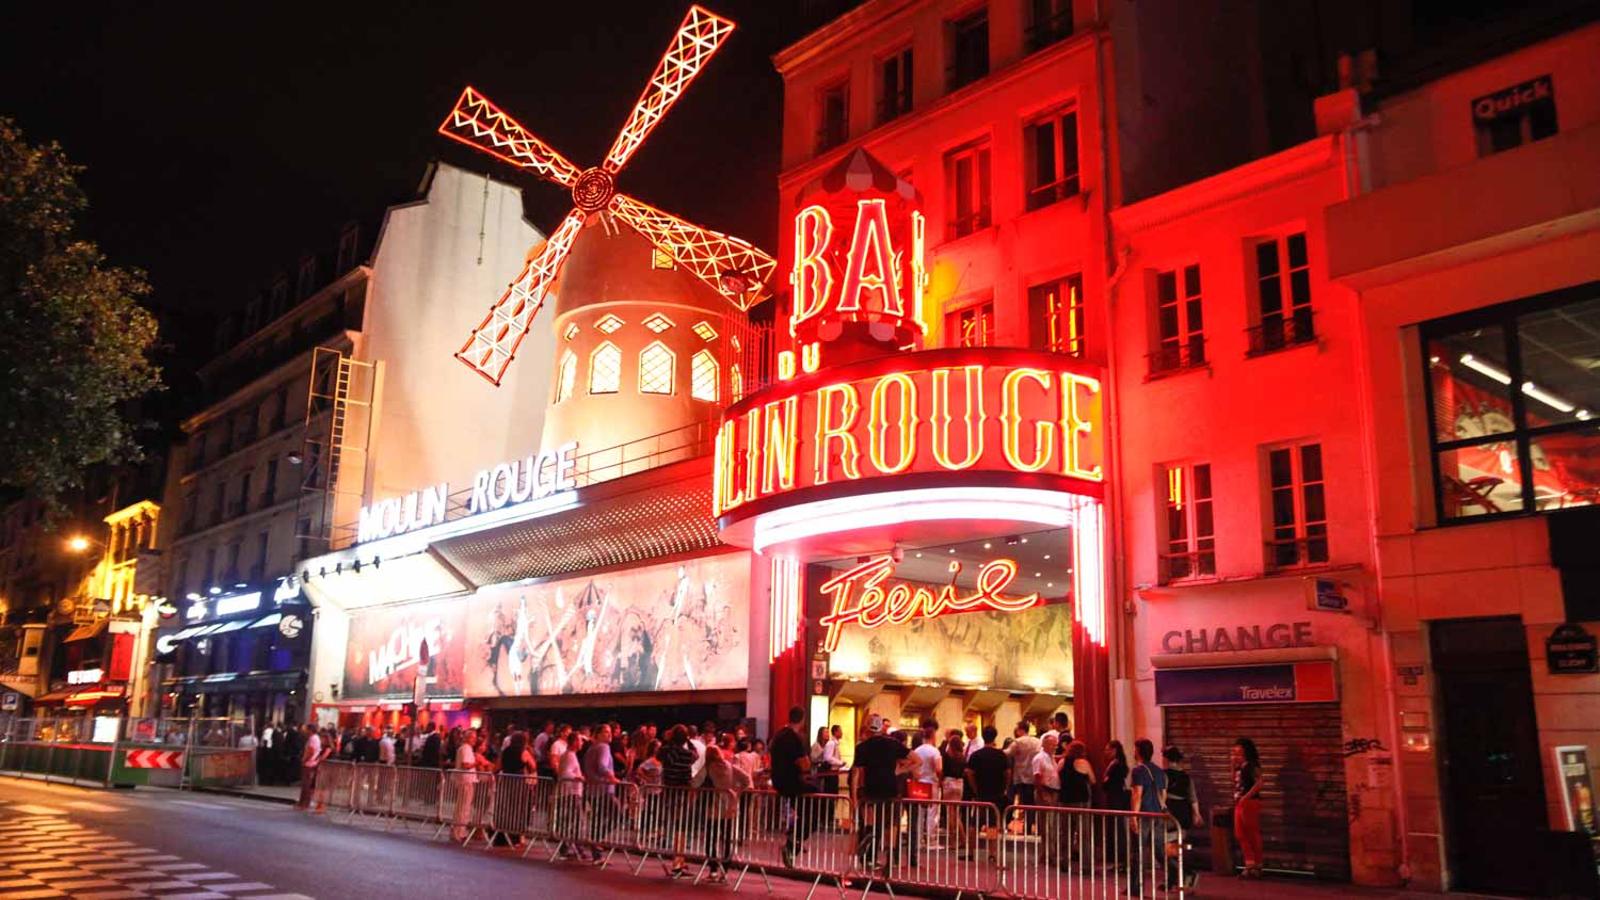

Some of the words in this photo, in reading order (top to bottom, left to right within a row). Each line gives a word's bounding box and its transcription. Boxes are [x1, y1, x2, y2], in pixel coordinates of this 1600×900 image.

[1475, 81, 1549, 117] Quick
[778, 342, 820, 381] DU
[713, 395, 799, 519] LIN
[813, 365, 1104, 482] ROUGE
[357, 482, 449, 544] MOULIN
[469, 442, 578, 514] ROUGE
[820, 556, 1038, 652] Féerie
[1161, 621, 1315, 655] CHANGE
[1239, 685, 1293, 700] Travelex
